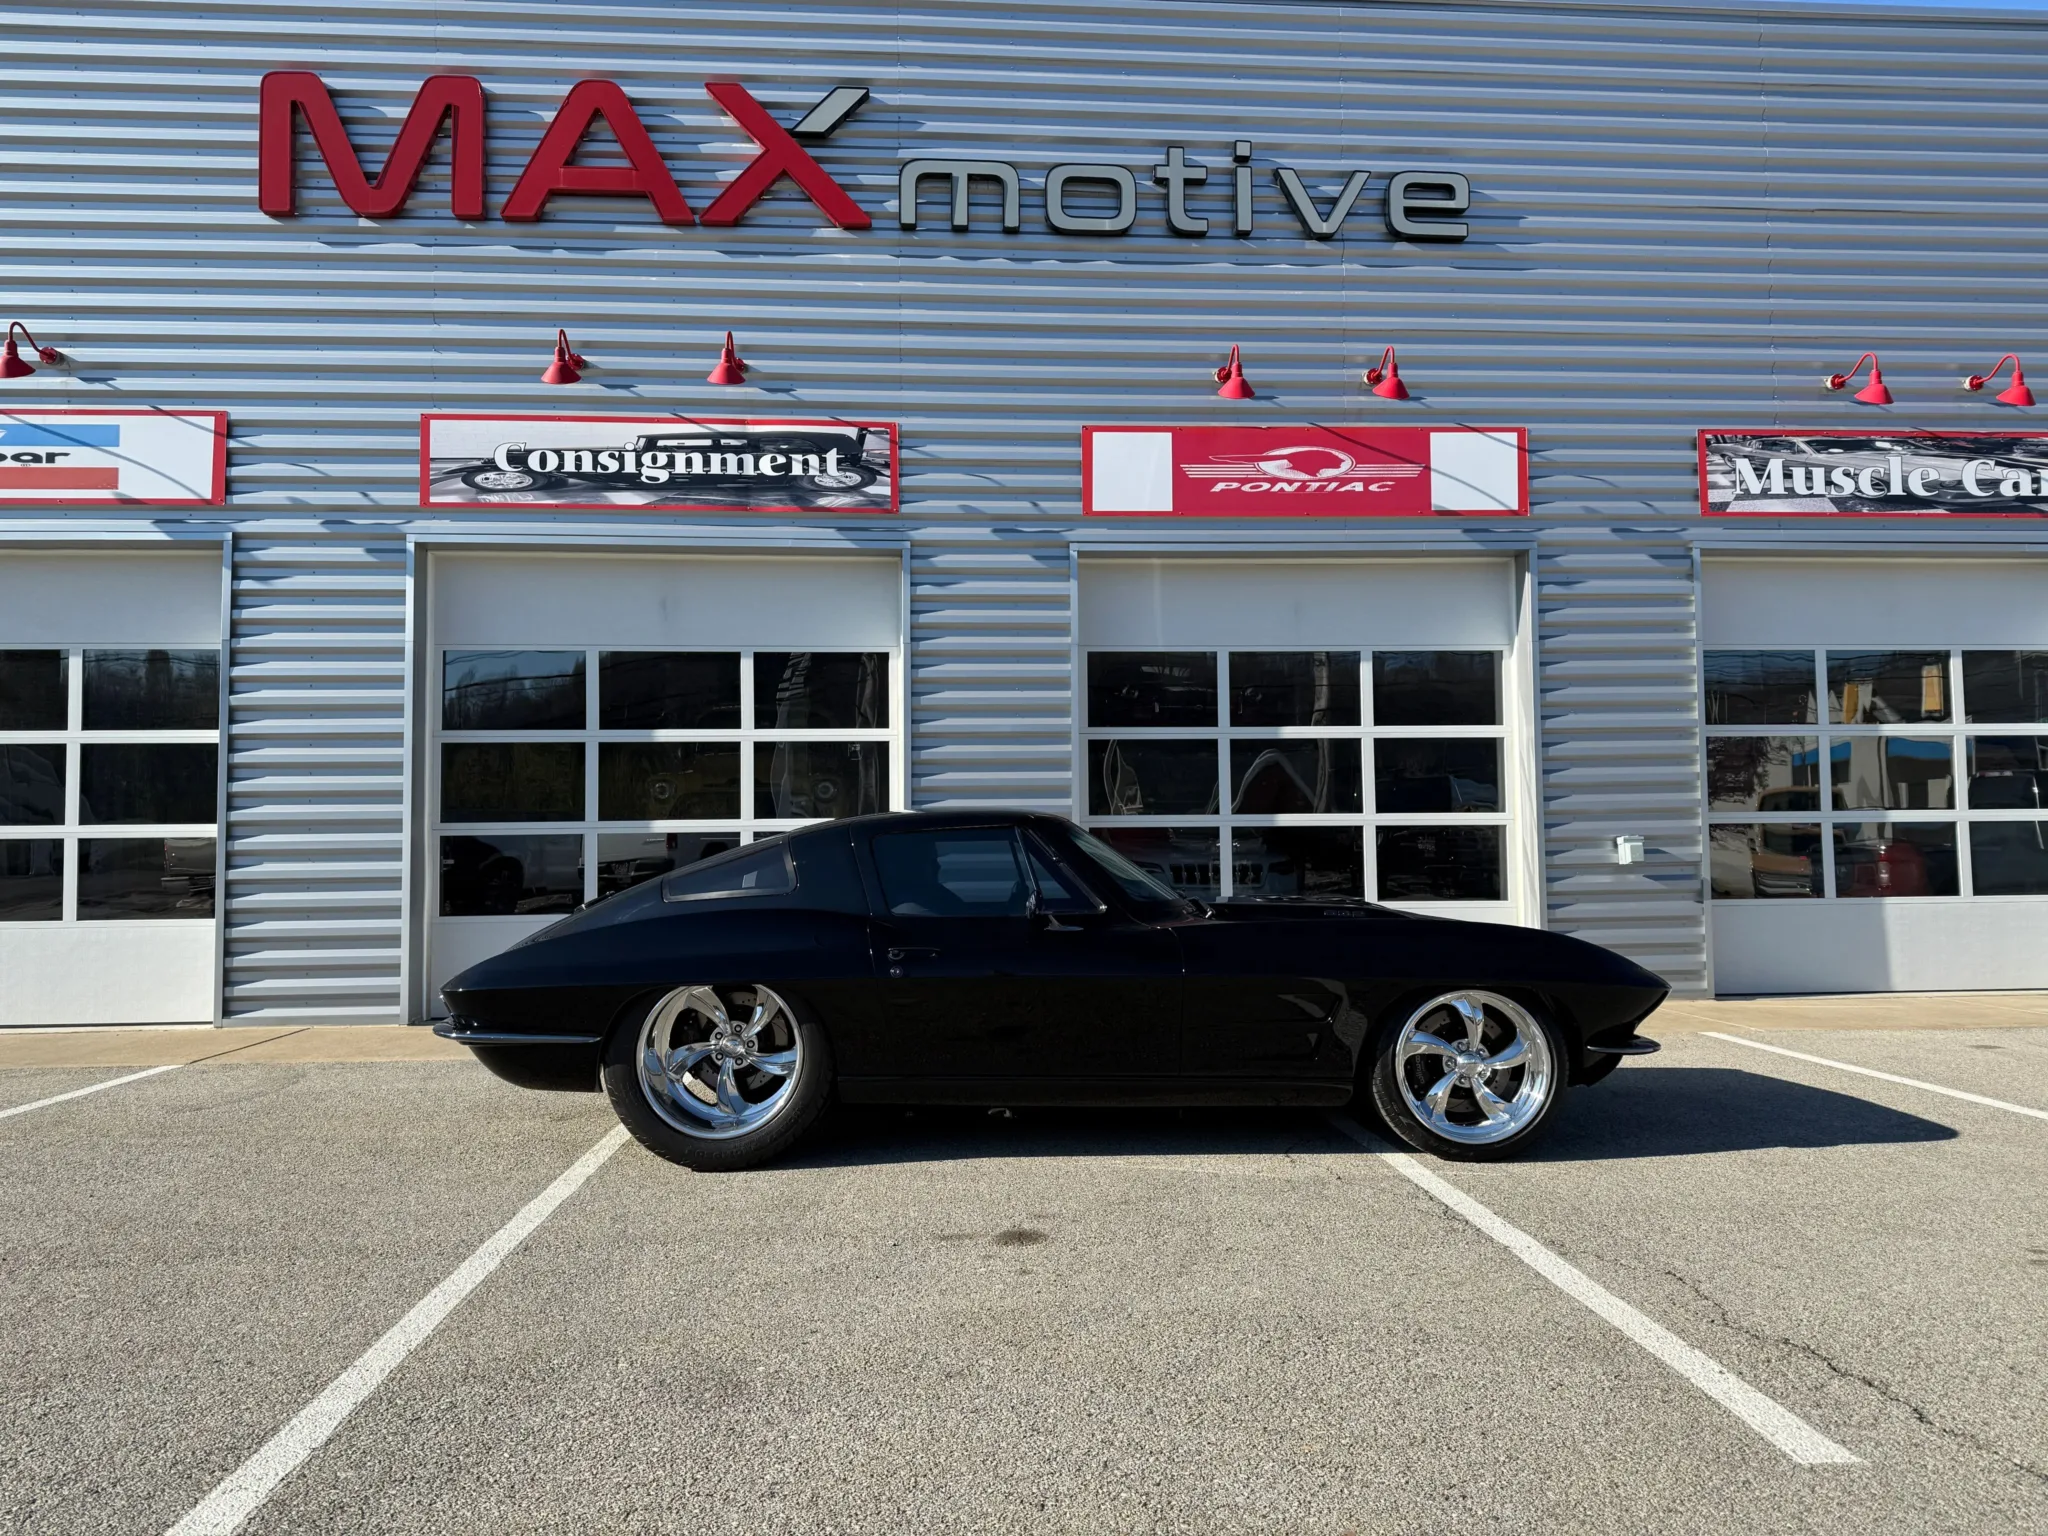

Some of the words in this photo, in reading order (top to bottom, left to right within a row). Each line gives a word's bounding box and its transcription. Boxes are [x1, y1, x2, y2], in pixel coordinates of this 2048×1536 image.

[493, 441, 846, 484] Consignment
[1731, 455, 1940, 498] Muscle
[1210, 481, 1396, 493] PONTIAC
